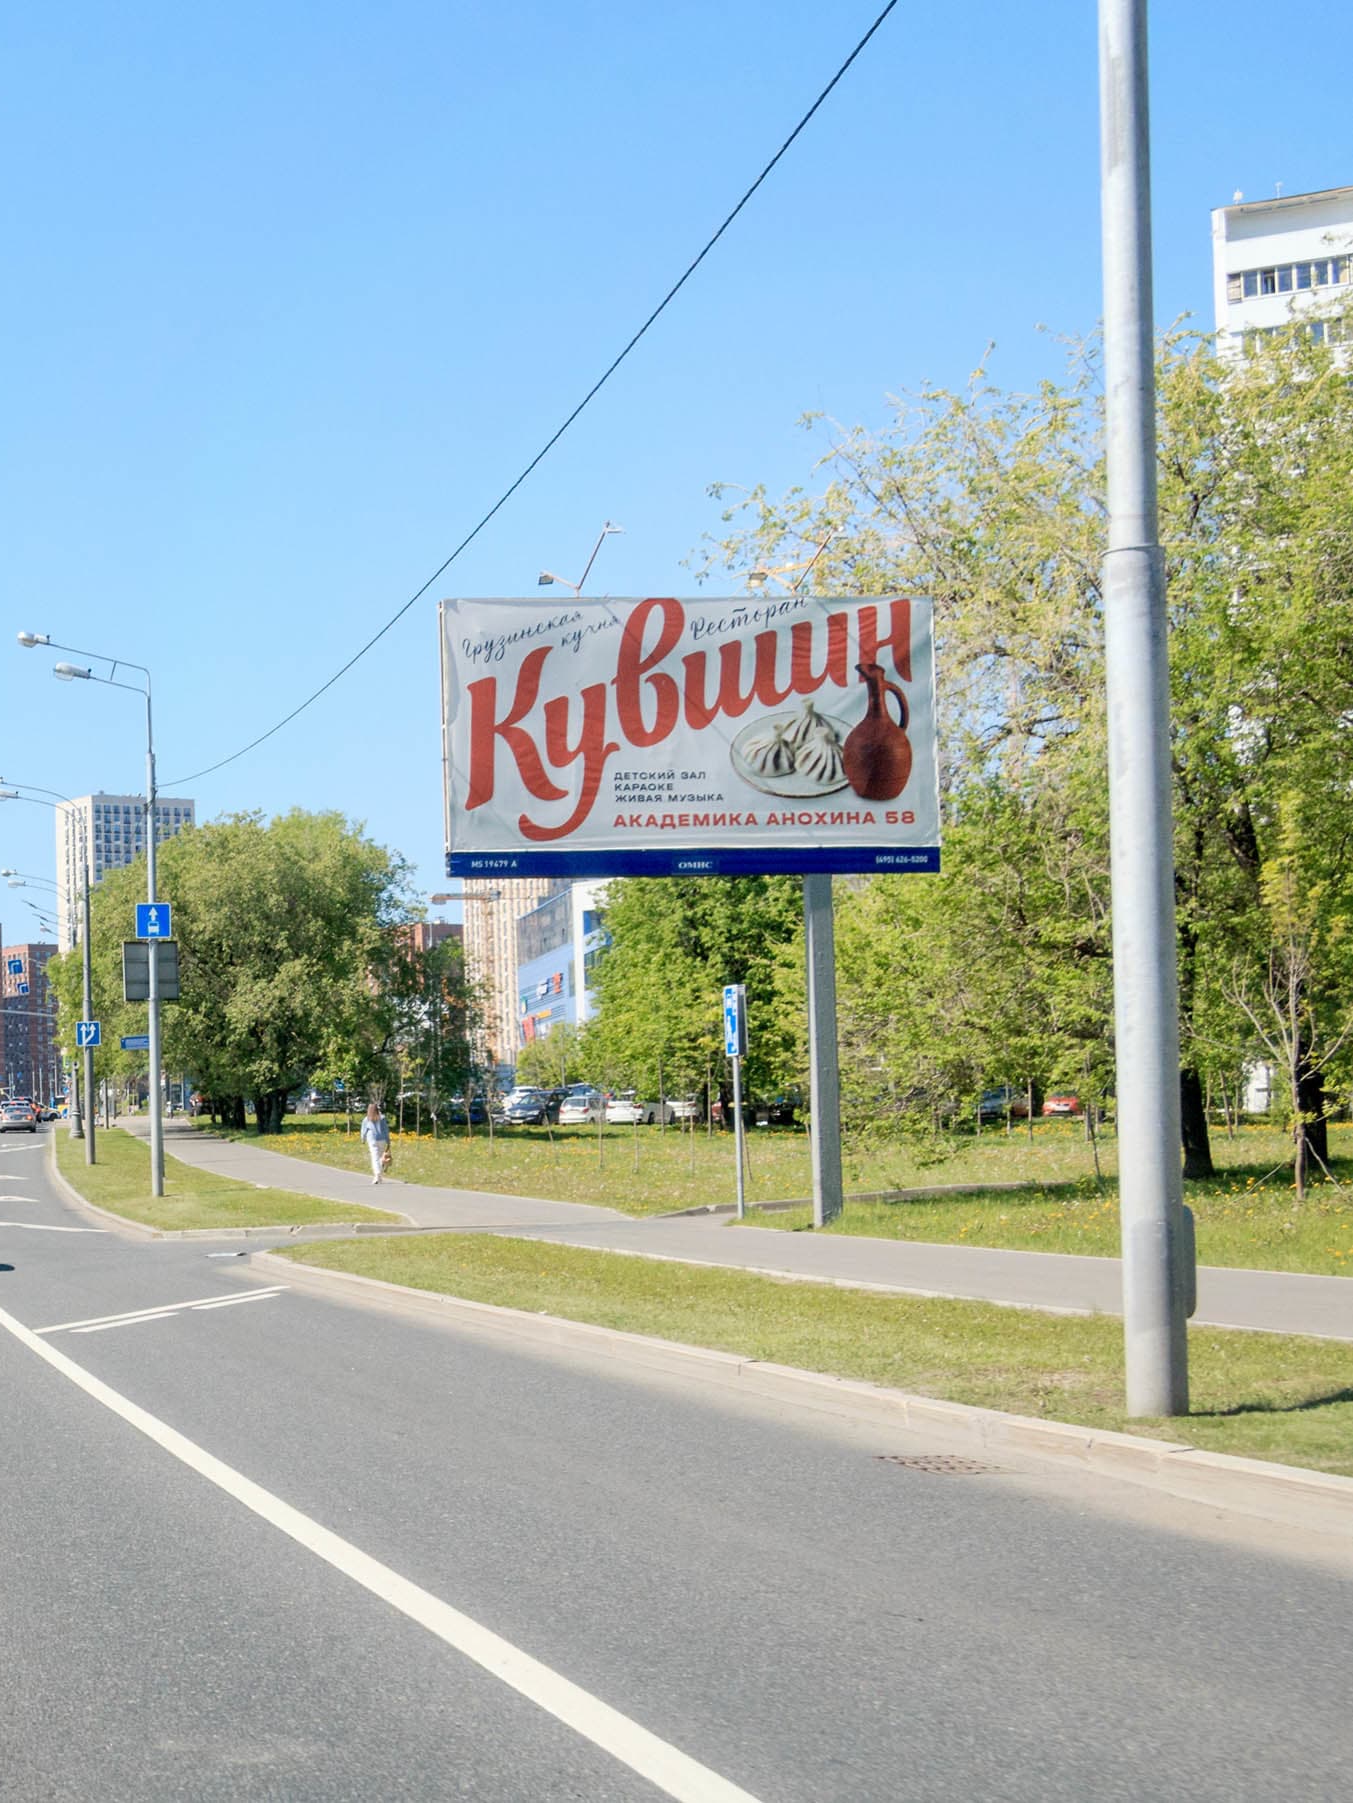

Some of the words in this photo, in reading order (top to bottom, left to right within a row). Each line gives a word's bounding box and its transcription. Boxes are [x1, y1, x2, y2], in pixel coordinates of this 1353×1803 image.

[690, 598, 808, 640] Ресторан
[462, 611, 584, 664] Грузинская
[560, 615, 622, 653] кухня
[464, 597, 913, 842] Кувшин
[613, 769, 676, 781] ДЕТСКИЙ
[680, 770, 707, 780] ЗАЛ
[614, 782, 674, 792] КАРАОКЕ
[615, 793, 663, 803] ЖИВАЯ
[667, 792, 725, 802] МУЗЫКА
[613, 812, 758, 829] АКАДЕМИКА
[766, 810, 876, 826] АНОХИНА
[884, 809, 916, 825] 58
